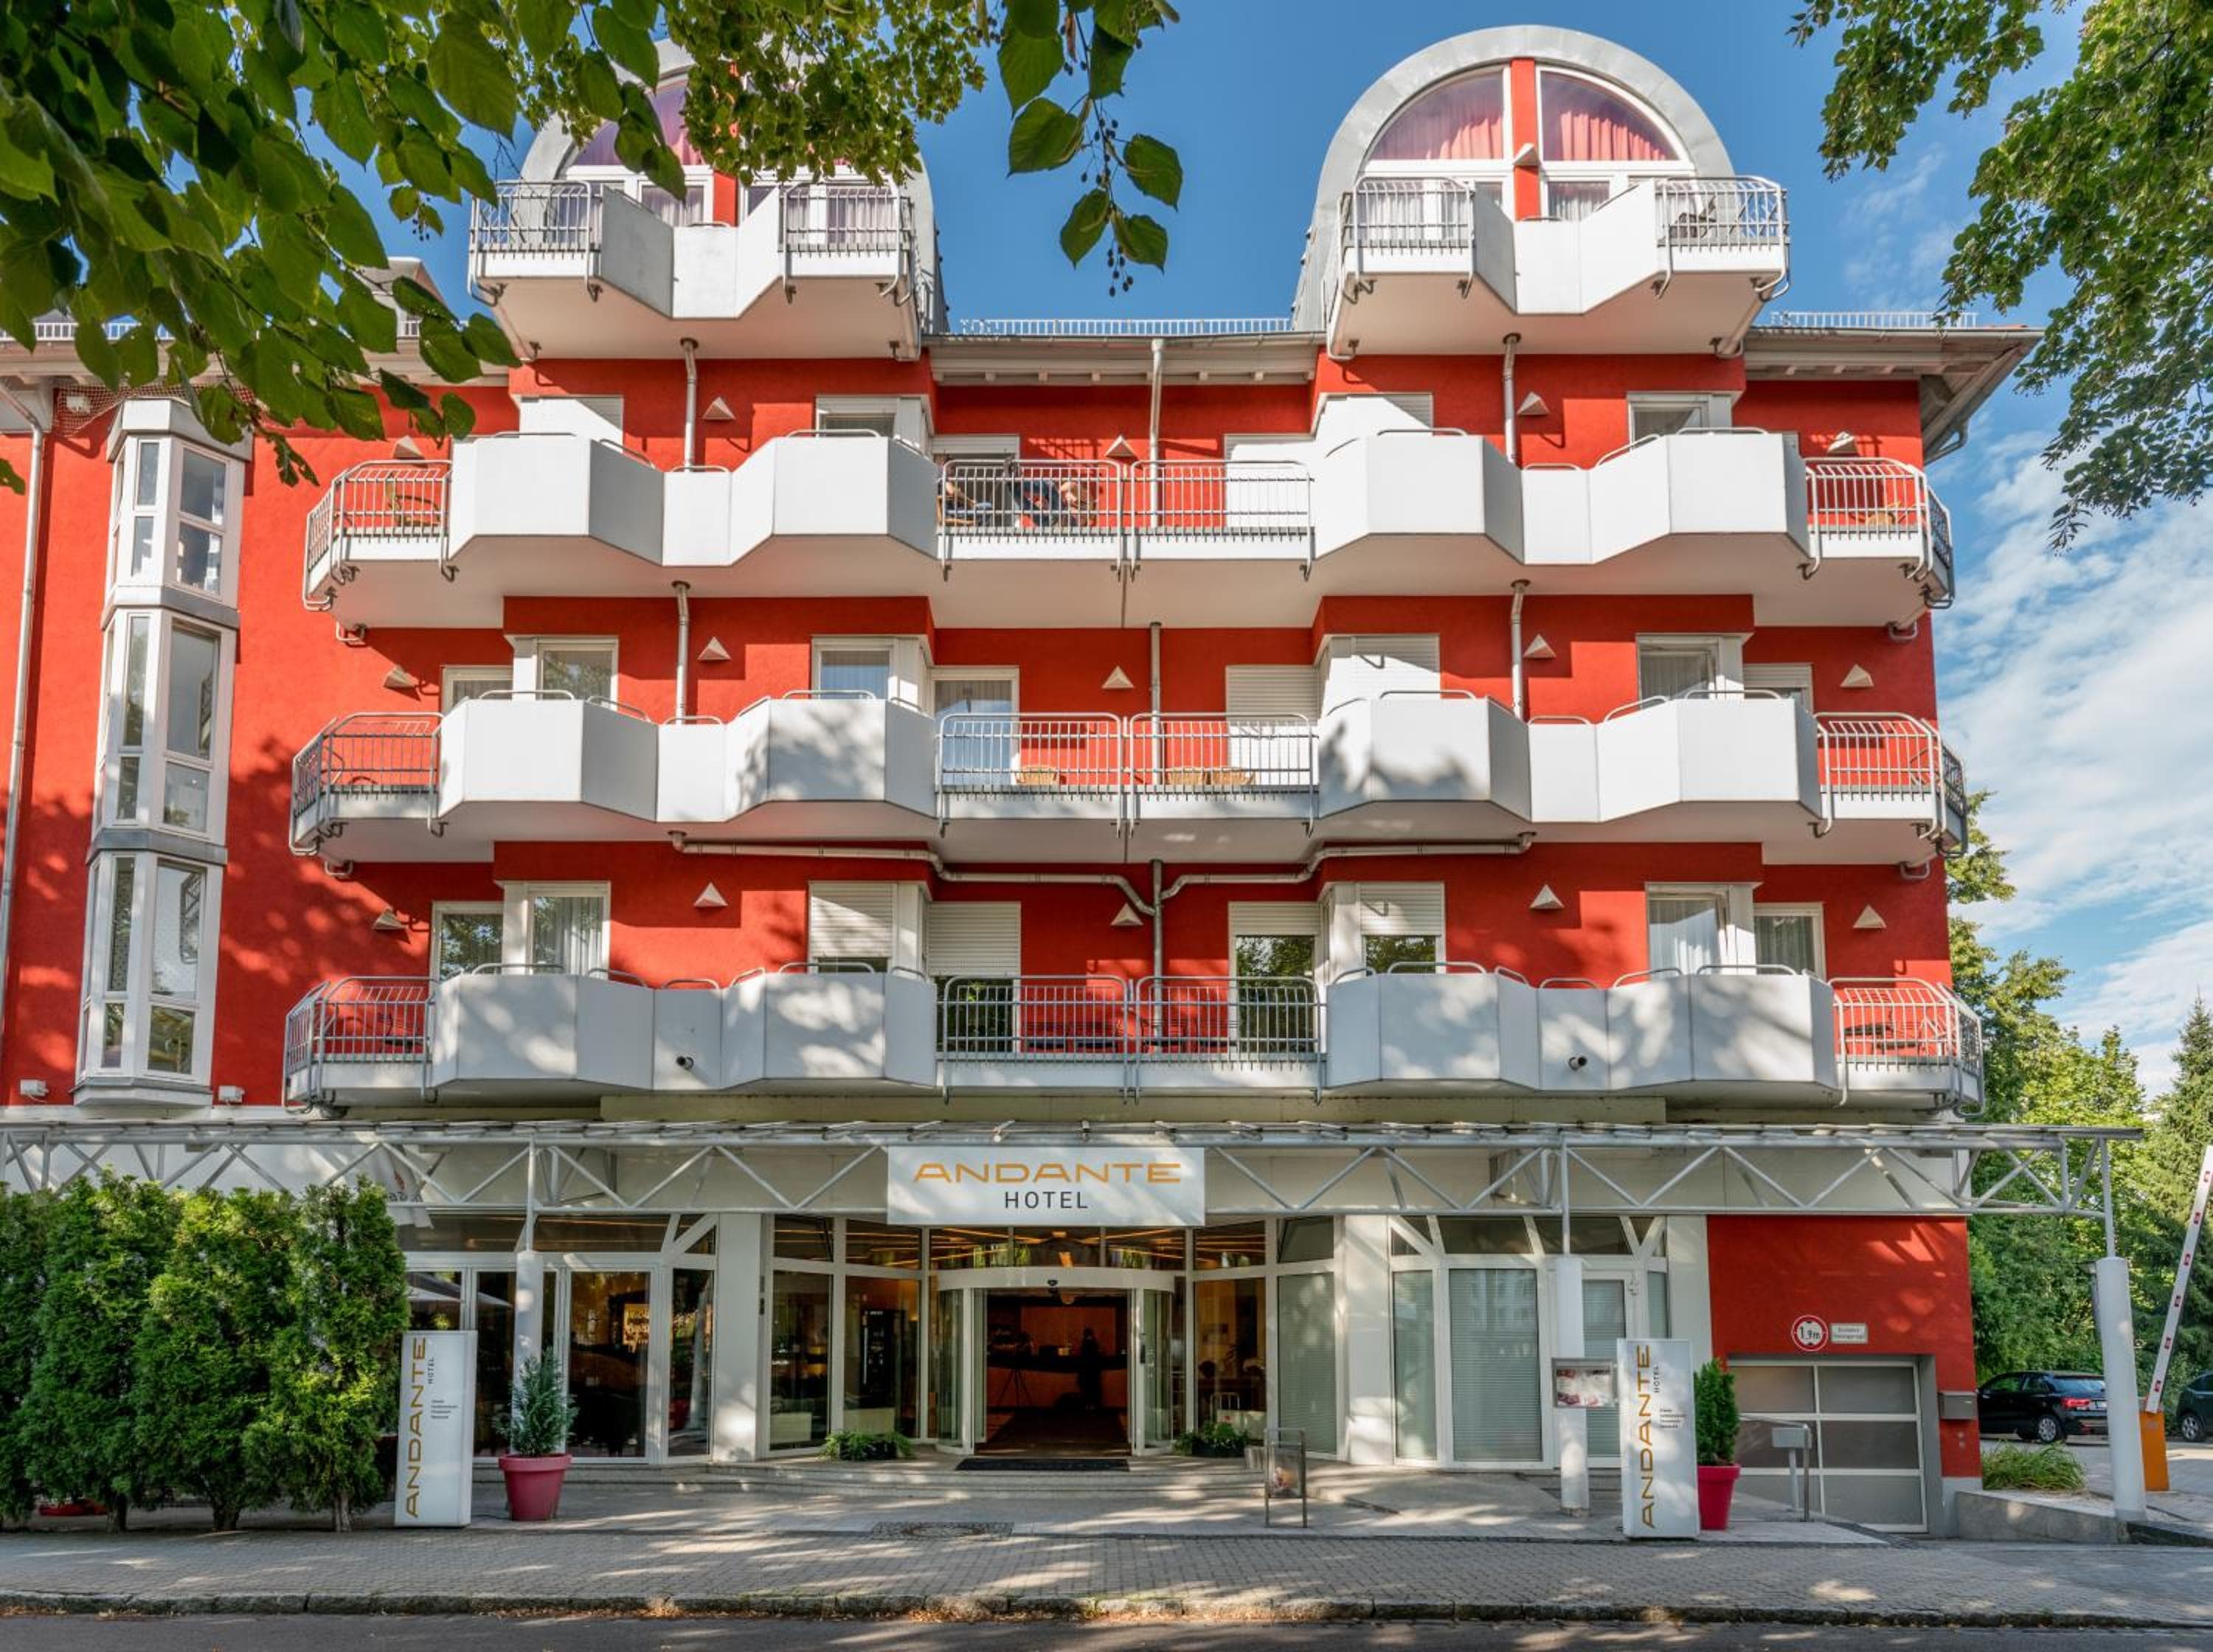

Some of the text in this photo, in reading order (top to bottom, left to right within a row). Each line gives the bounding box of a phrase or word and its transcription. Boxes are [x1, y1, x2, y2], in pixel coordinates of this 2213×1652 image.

[914, 1163, 1181, 1184] ANDANTE
[1005, 1191, 1088, 1209] HOTEL
[405, 1337, 426, 1518] ANDANTE
[1636, 1344, 1655, 1529] ANDANTE
